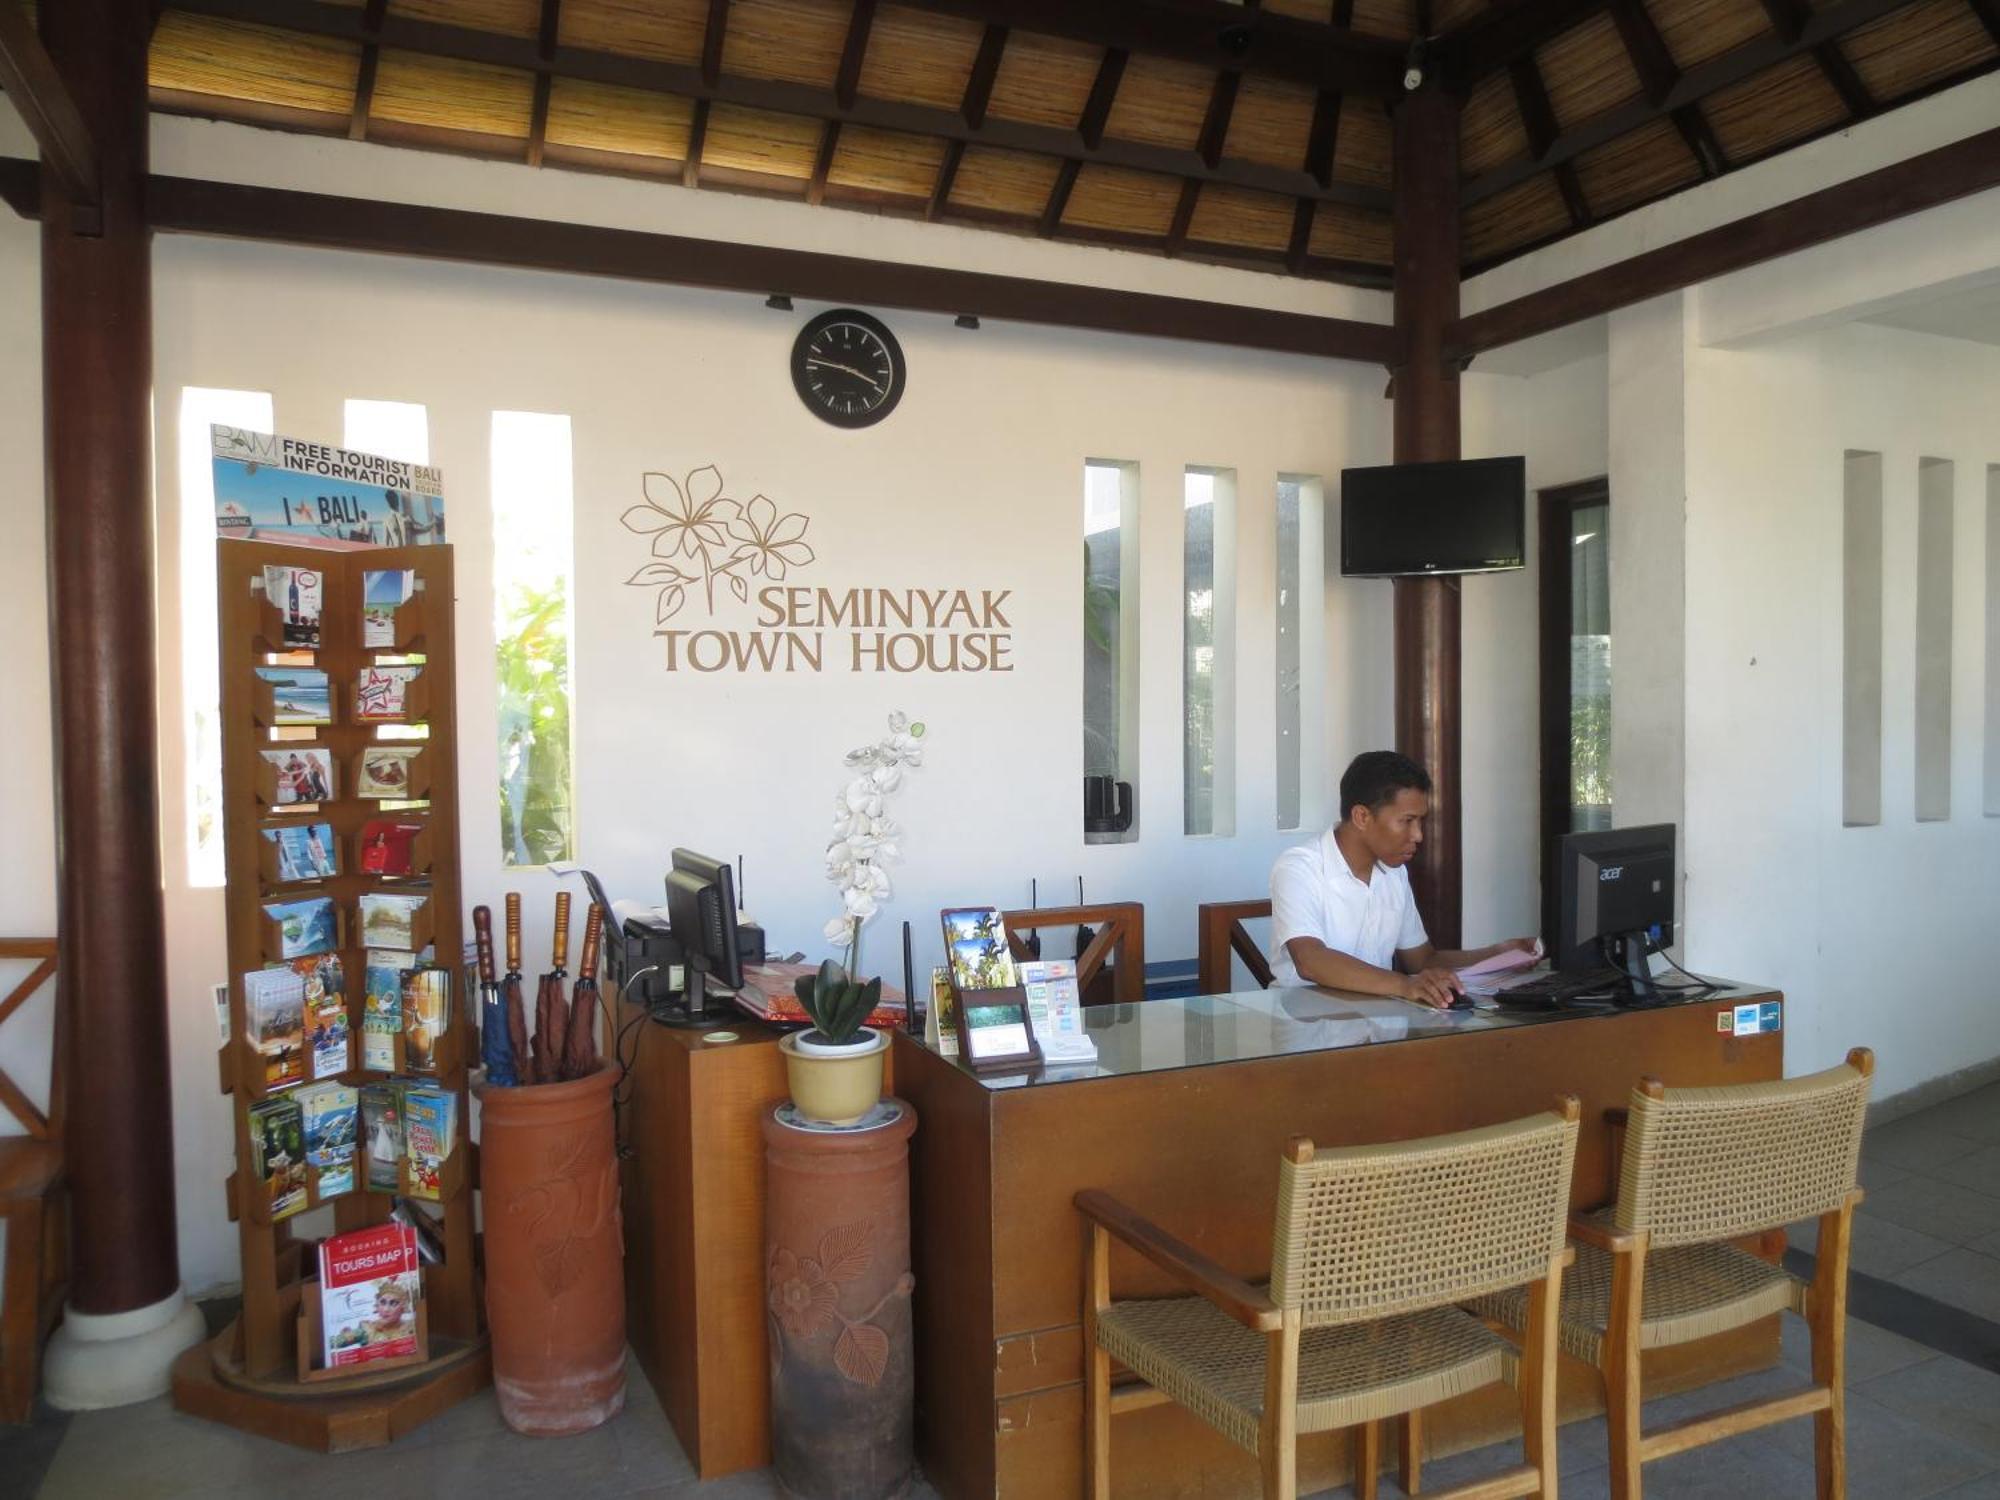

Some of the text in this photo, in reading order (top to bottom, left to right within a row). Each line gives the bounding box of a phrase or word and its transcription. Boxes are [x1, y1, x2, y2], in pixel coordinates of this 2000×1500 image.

[214, 424, 277, 457] BAM
[283, 440, 410, 476] FREE TOURIST
[284, 455, 410, 489] INFORMATION
[415, 465, 442, 481] BALI
[283, 495, 360, 526] I BALI
[757, 586, 1012, 629] SEMINYAK
[653, 630, 1014, 673] TOWN HOUSE
[1600, 867, 1624, 881] acer
[333, 1256, 375, 1274] TOURS
[376, 1249, 402, 1265] MAP
